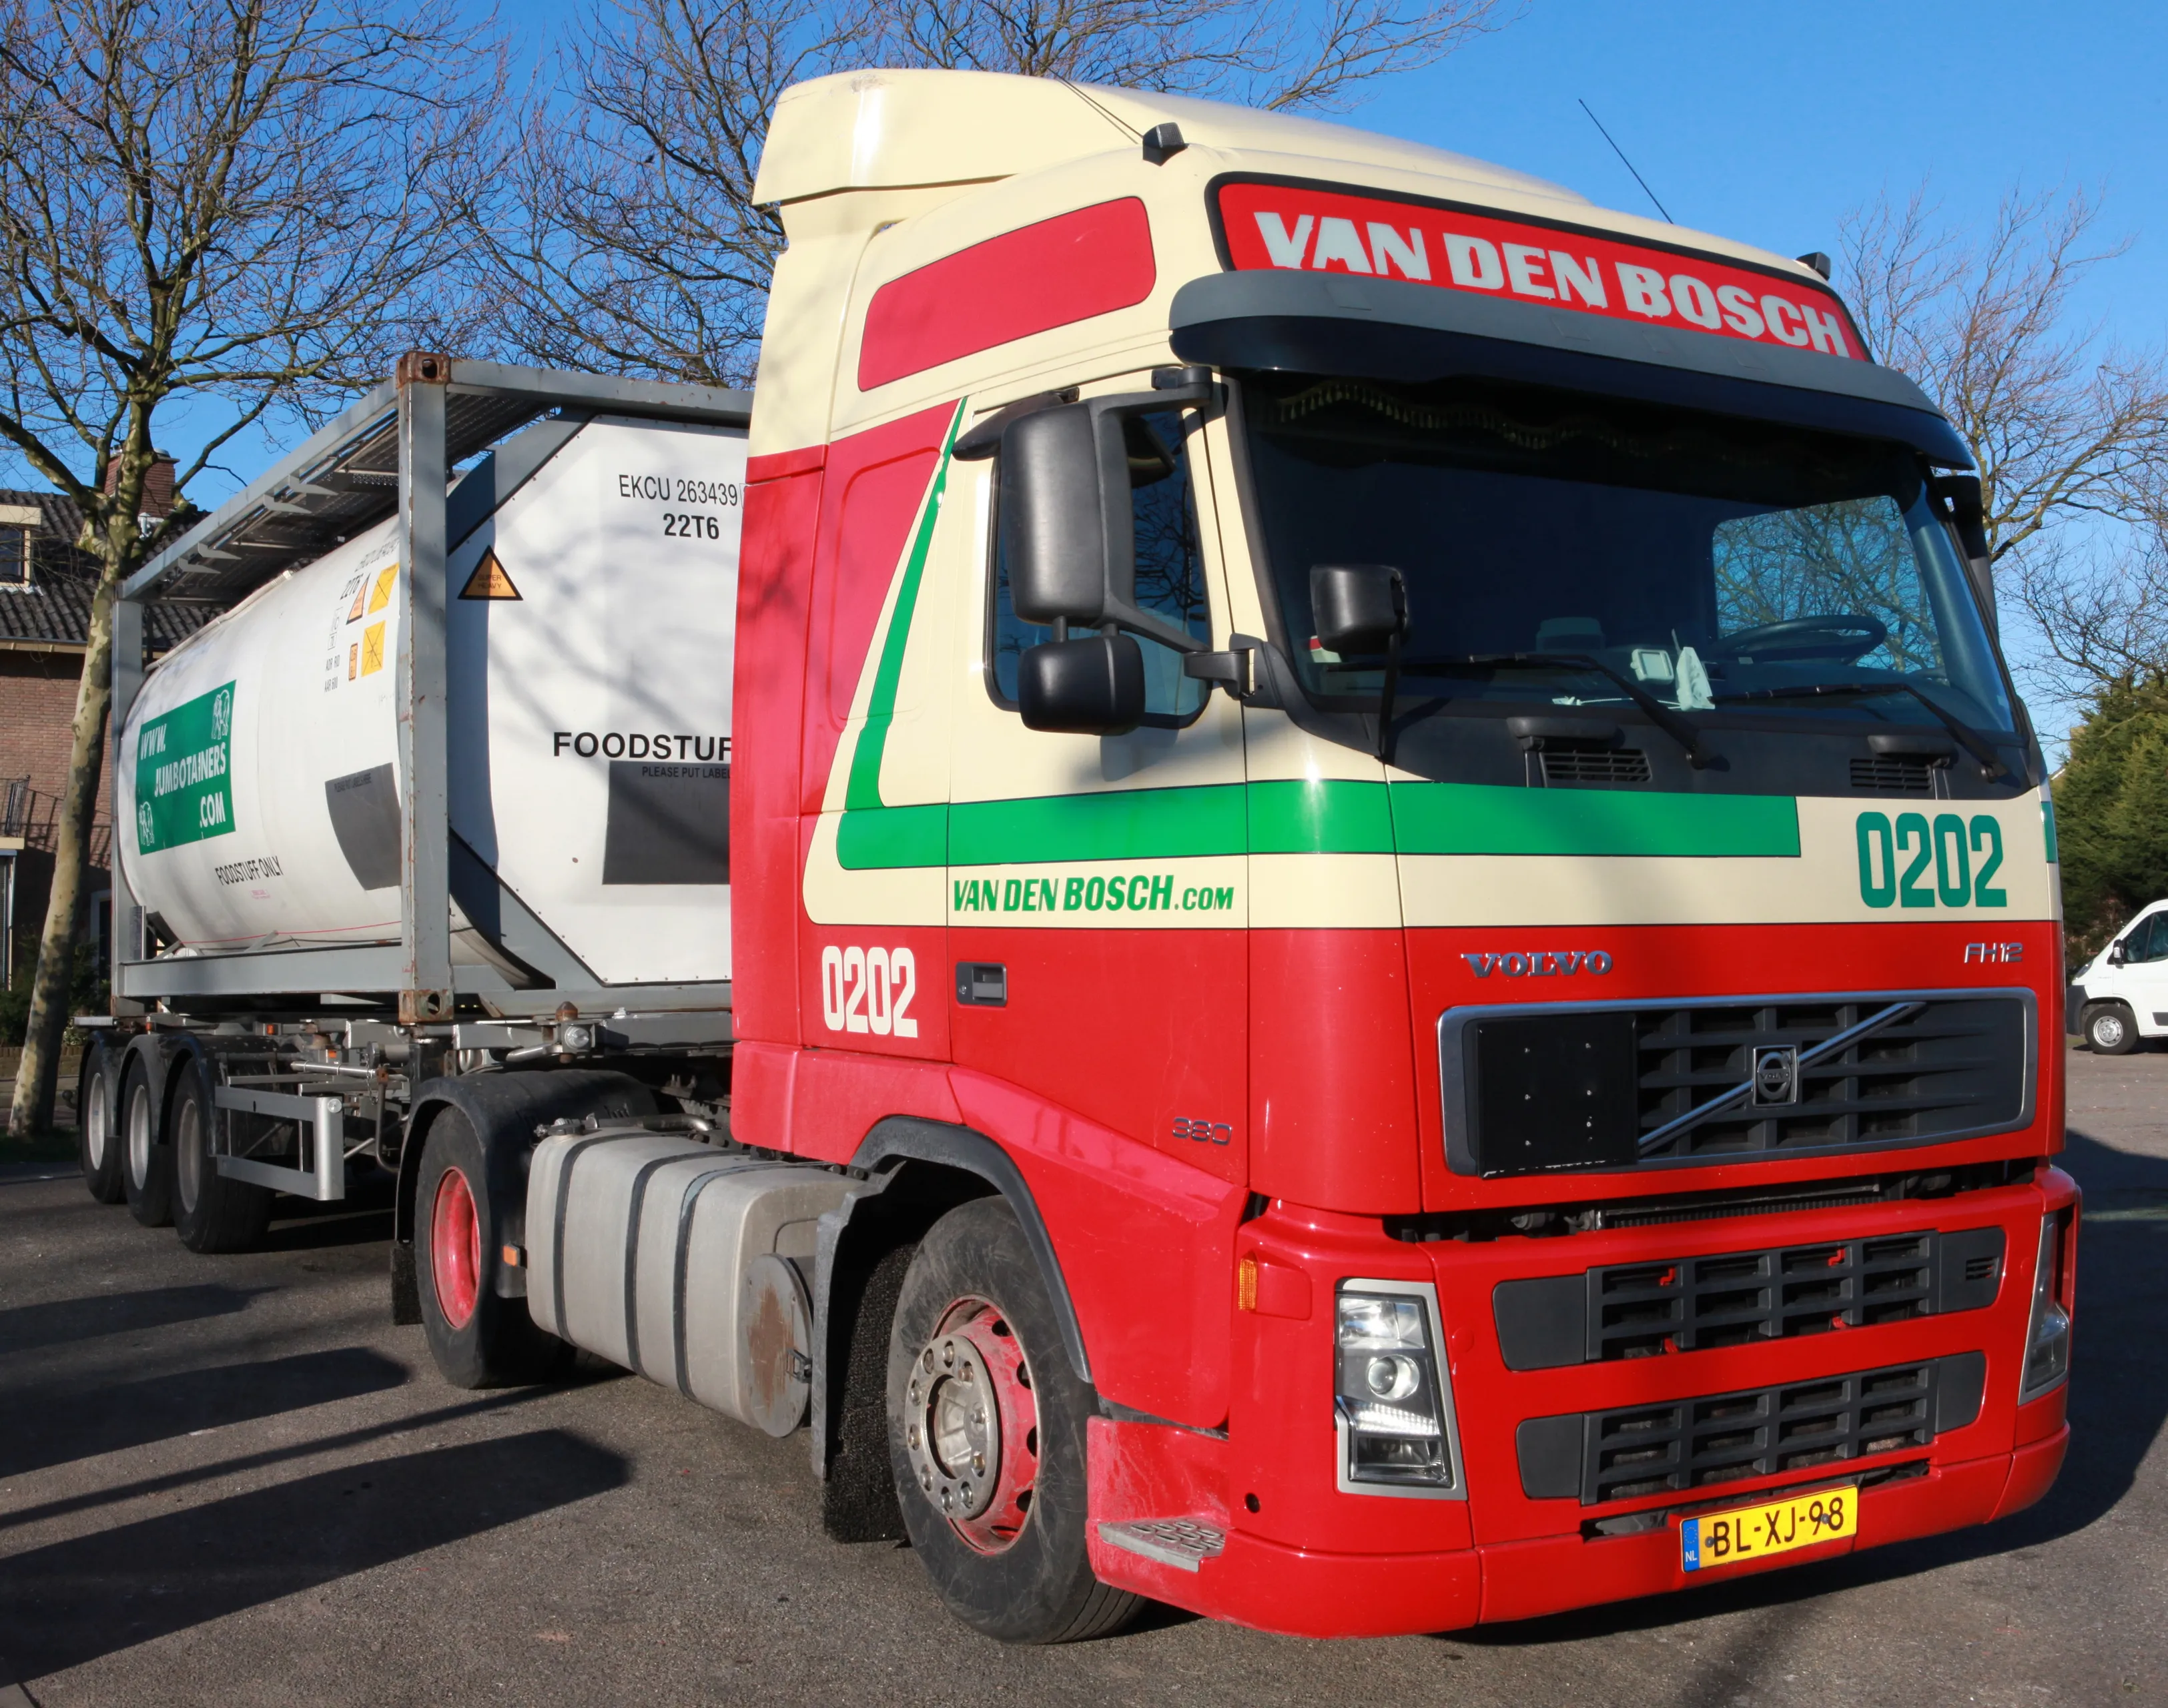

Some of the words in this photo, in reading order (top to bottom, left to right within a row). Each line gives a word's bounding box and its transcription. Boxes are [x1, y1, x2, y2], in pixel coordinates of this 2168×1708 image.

[1253, 211, 1431, 281] VAN
[1443, 232, 1609, 310] DEN
[1613, 262, 1850, 359] BOSCH
[619, 474, 671, 500] EKCU
[677, 479, 738, 506] 263439
[663, 513, 720, 540] 22T6
[140, 723, 167, 760] WWW.
[154, 742, 226, 797] JUMBOTAINERS
[642, 766, 679, 777] PLEASE
[682, 767, 700, 778] PUT
[215, 859, 261, 885] FOODSTUFF
[258, 855, 284, 878] ONLY
[1856, 811, 2008, 908] 0202
[954, 879, 1000, 911] VAN
[1003, 878, 1060, 911] DEN
[1461, 950, 1613, 978] VOLVO
[1964, 942, 2023, 963] FH12
[821, 945, 918, 1038] 0202
[1172, 1116, 1232, 1146] 380
[1713, 1497, 1844, 1557] BL-XJ-98
[1685, 1550, 1698, 1563] NL
